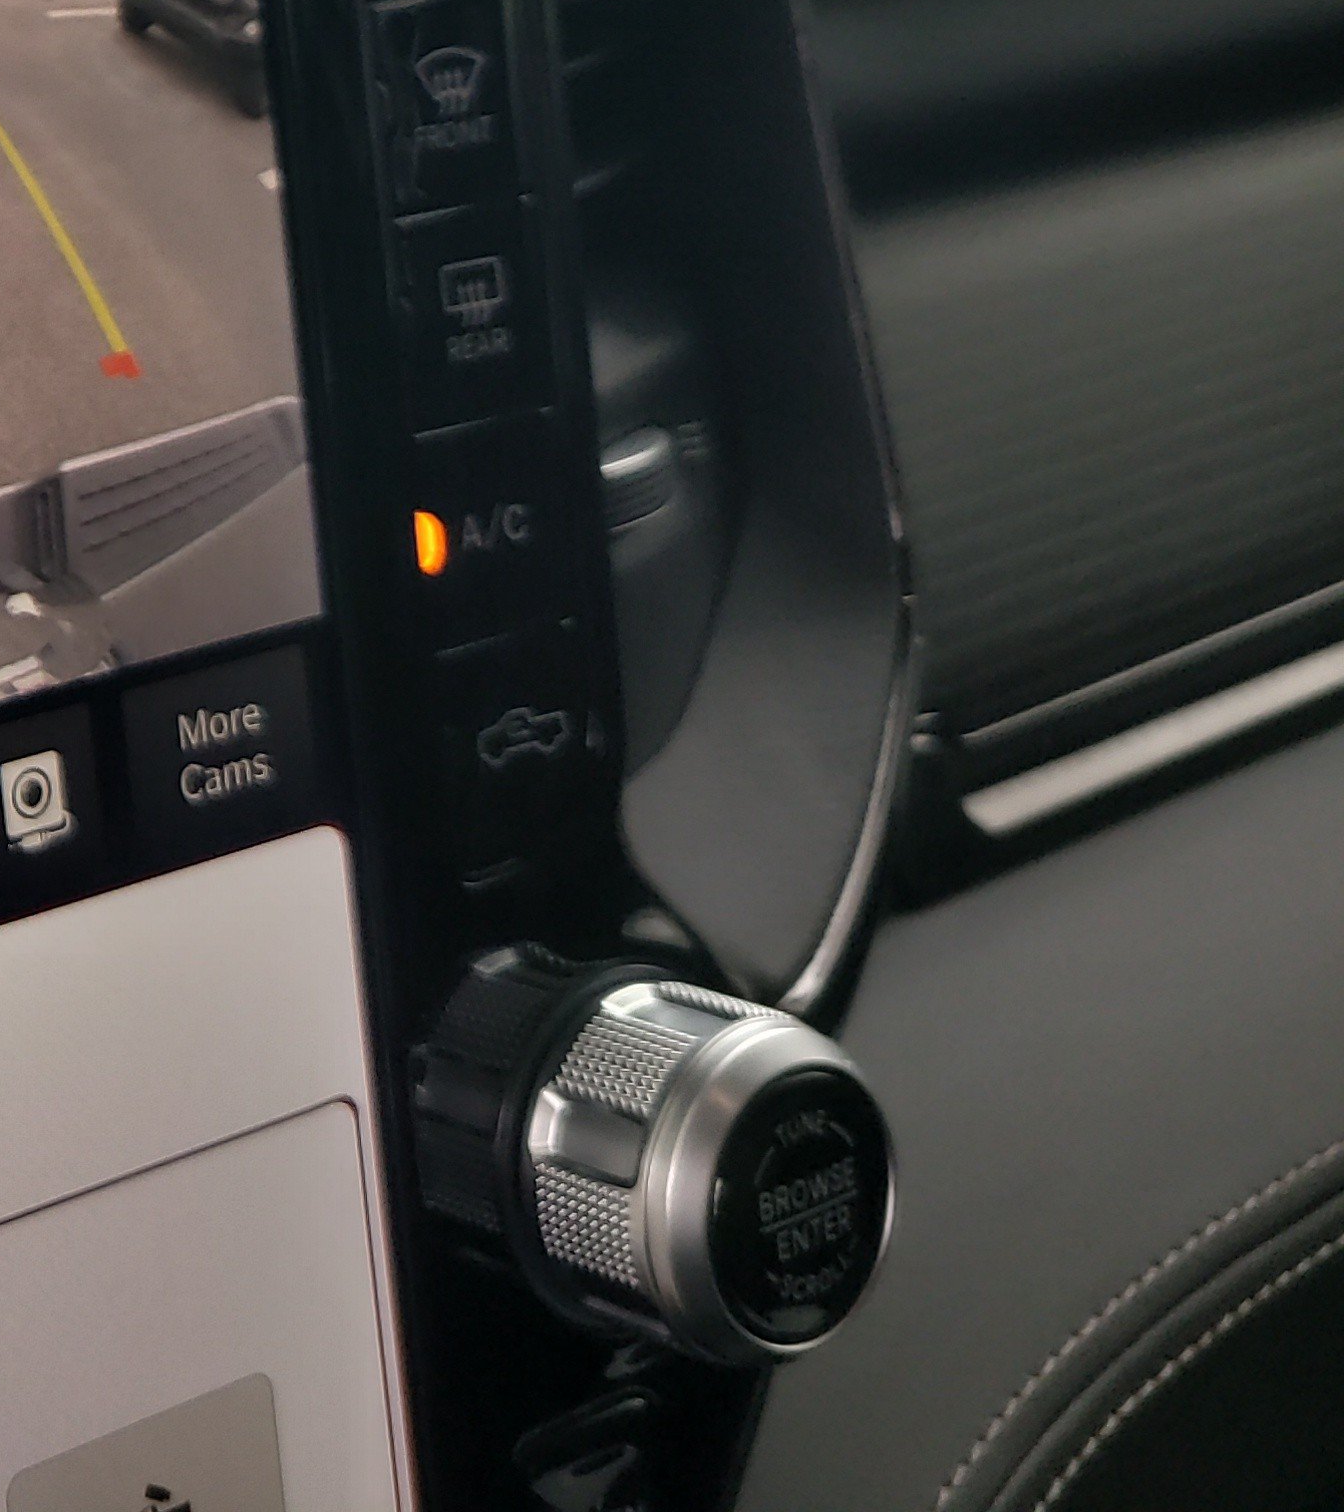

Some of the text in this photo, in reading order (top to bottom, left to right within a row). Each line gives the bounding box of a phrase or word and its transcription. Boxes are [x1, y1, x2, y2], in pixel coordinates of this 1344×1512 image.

[461, 502, 531, 552] A/C
[176, 701, 265, 753] More
[179, 752, 274, 808] Cams
[758, 1155, 857, 1224] BROWSE
[775, 1203, 855, 1262] ENTER
